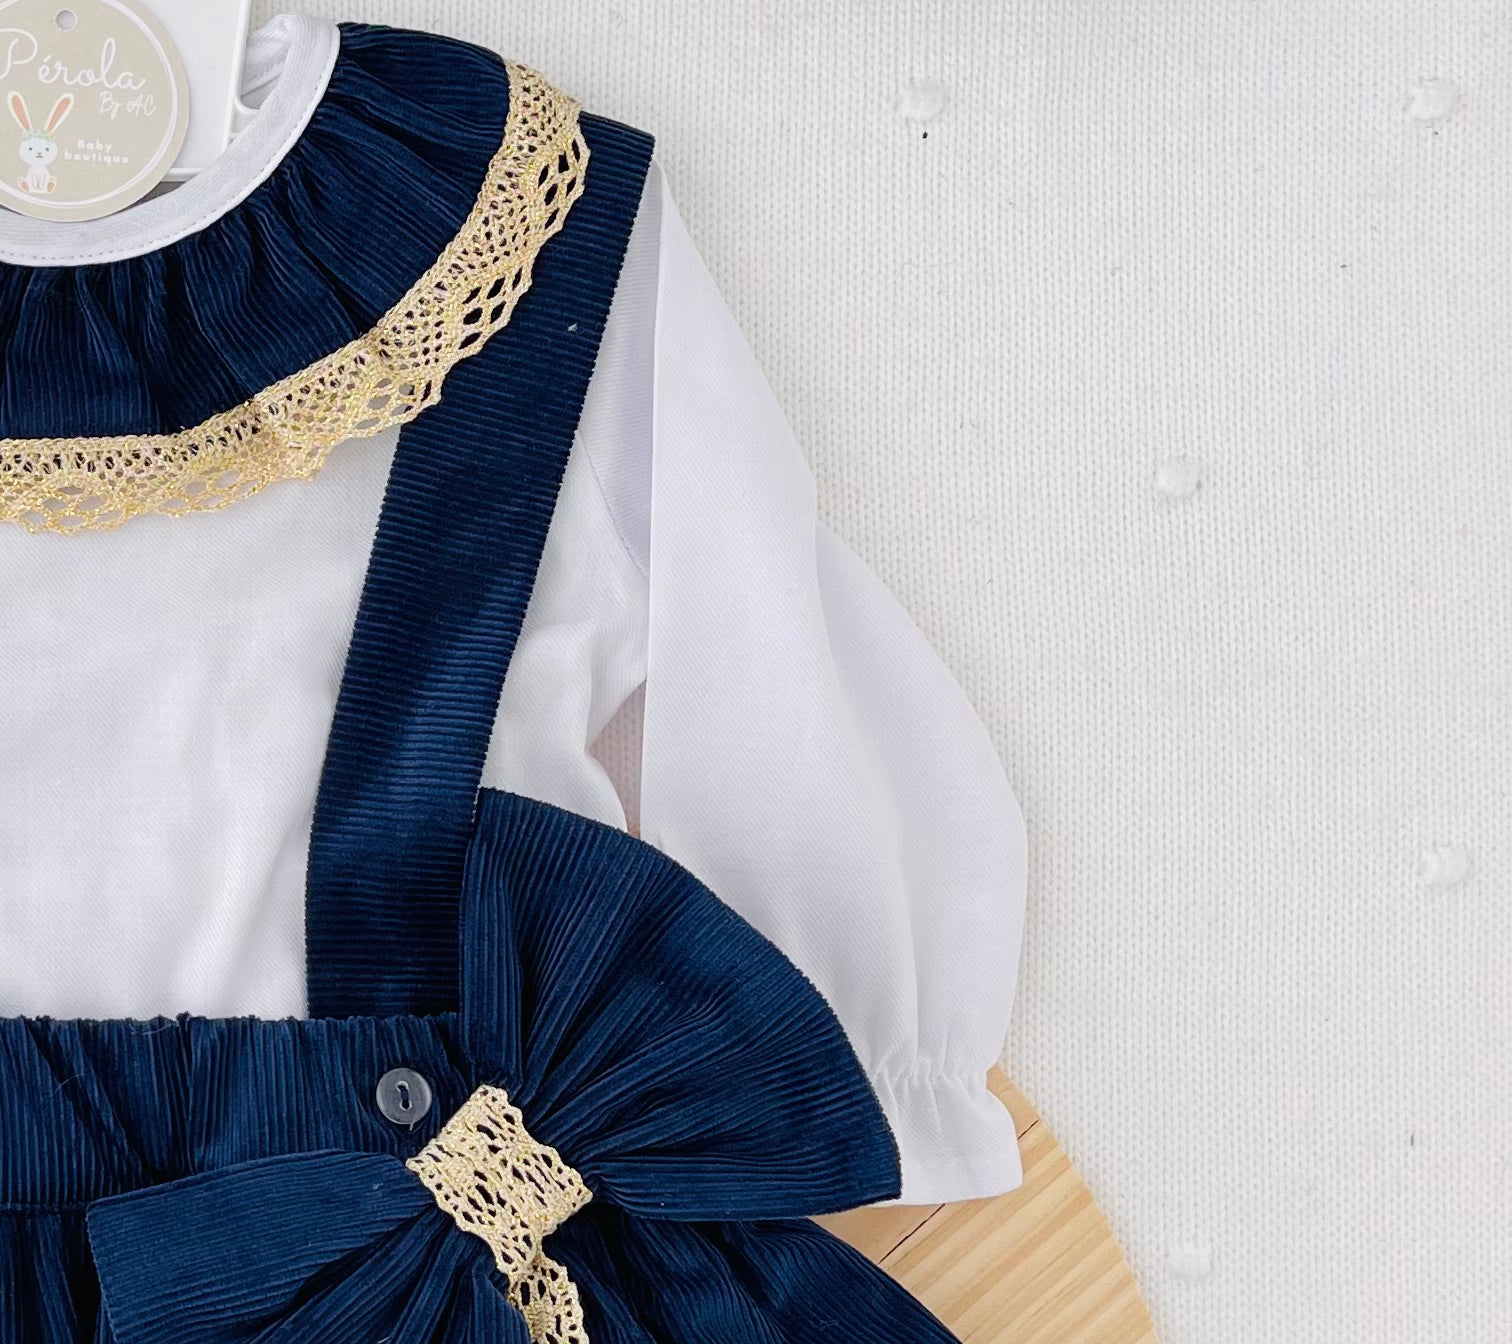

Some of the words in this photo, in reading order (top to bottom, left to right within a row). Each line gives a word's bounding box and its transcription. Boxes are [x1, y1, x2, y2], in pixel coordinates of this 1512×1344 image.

[99, 90, 122, 120] By
[77, 139, 112, 152] Baby
[64, 151, 129, 164] boutique
